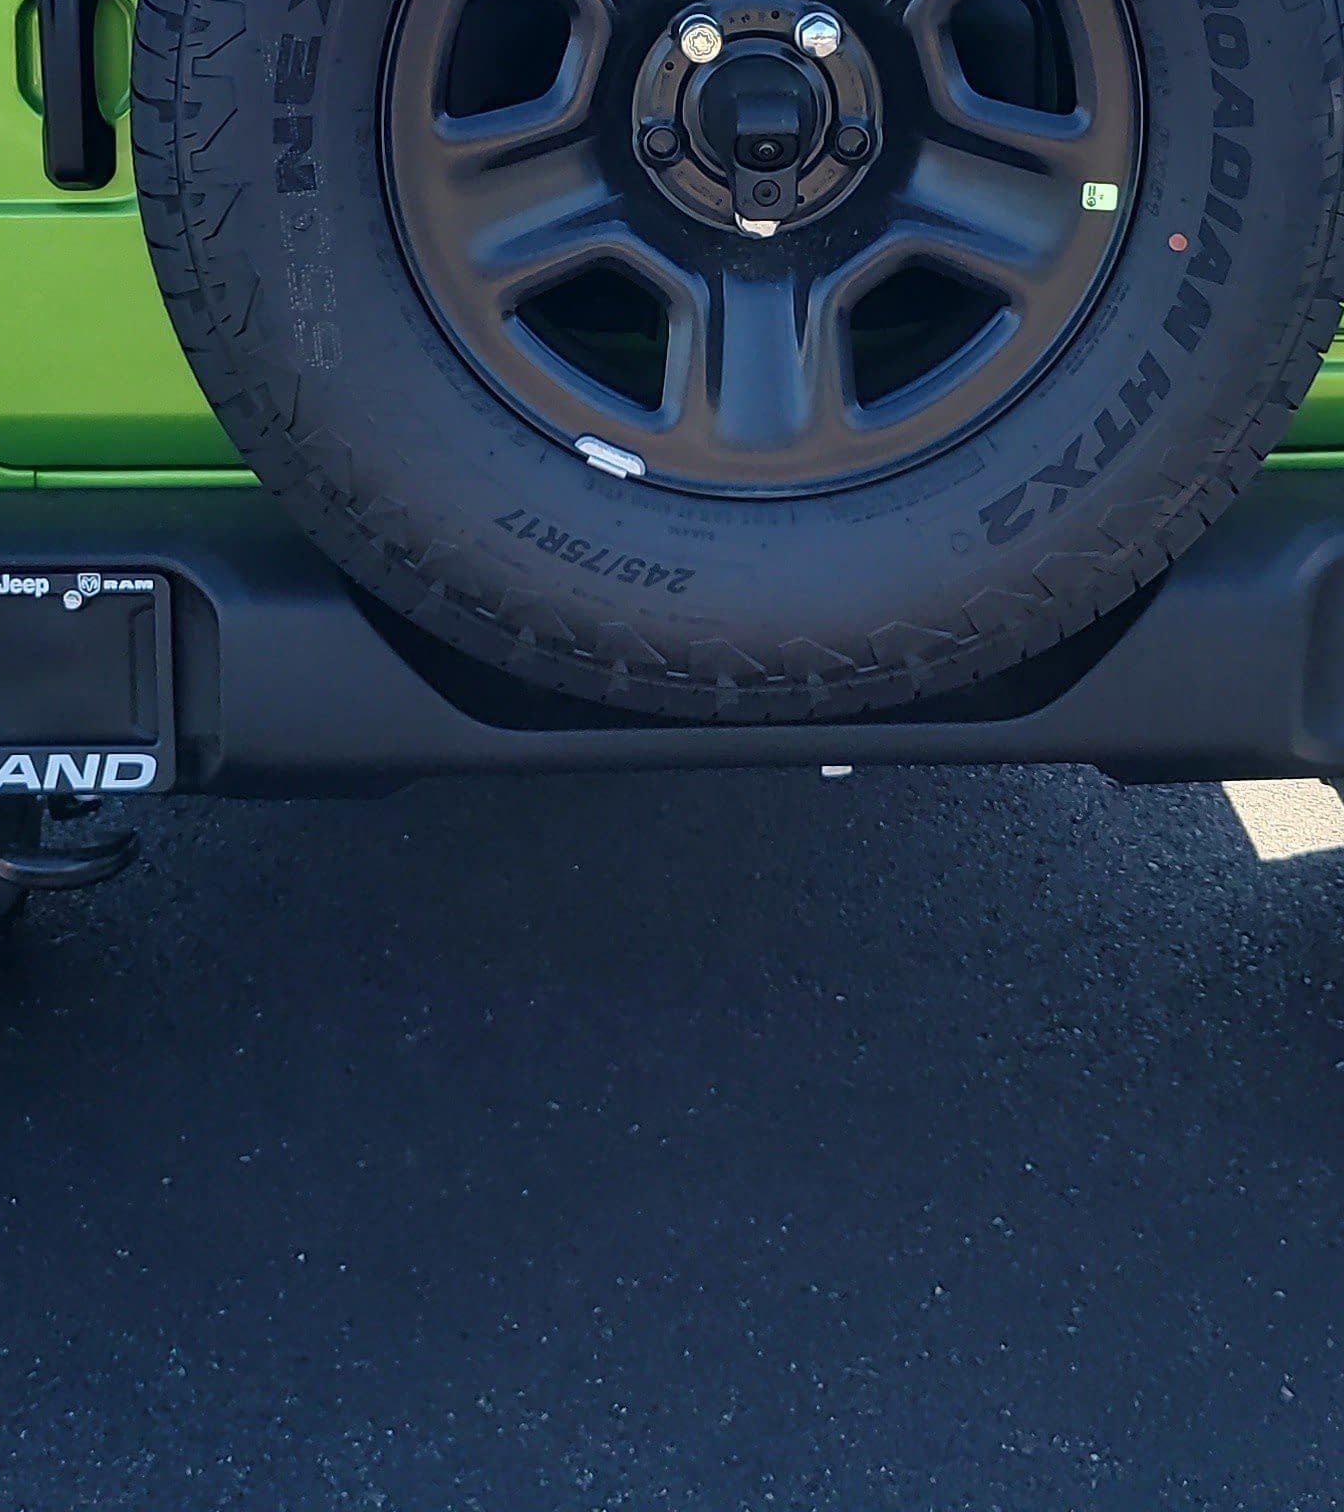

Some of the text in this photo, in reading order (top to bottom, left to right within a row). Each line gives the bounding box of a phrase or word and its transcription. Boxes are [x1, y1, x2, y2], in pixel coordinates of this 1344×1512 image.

[977, 351, 1172, 548] HTX2
[103, 579, 154, 590] RAM
[493, 508, 697, 594] 245/75R17
